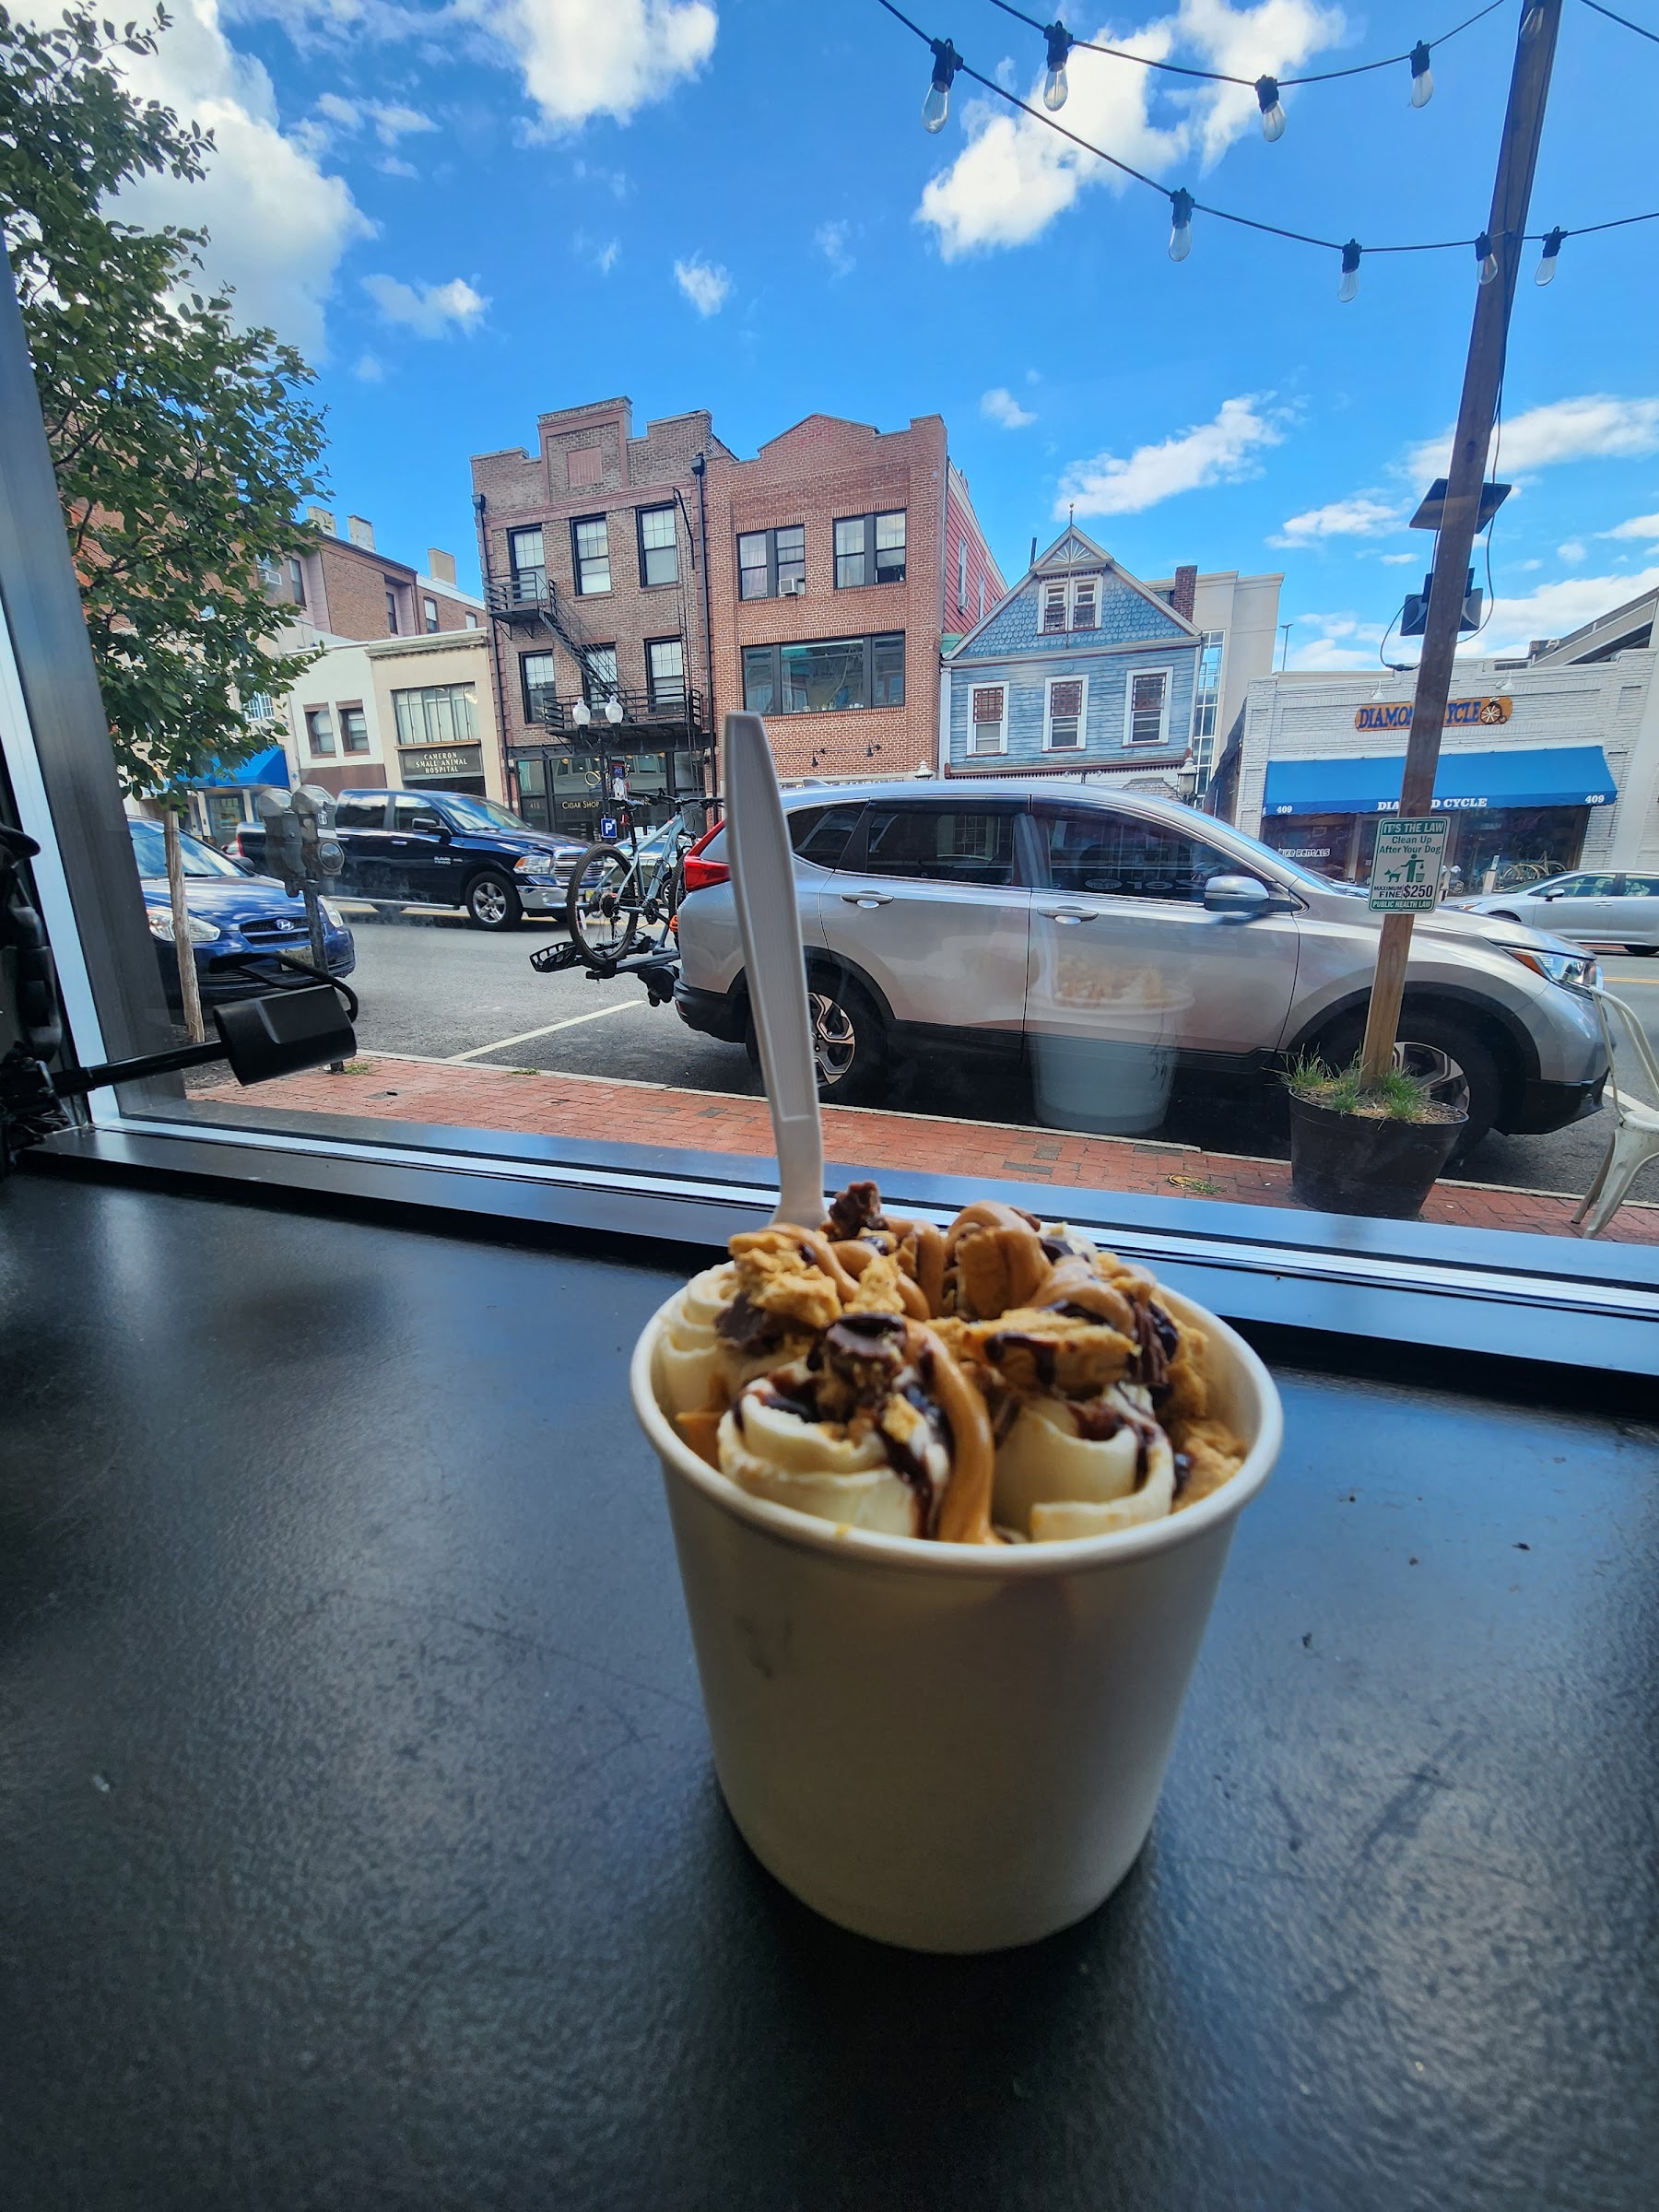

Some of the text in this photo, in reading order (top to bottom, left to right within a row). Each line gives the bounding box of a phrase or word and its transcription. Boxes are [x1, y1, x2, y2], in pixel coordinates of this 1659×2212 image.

[1359, 701, 1481, 728] DIAMO YCLE
[424, 751, 457, 760] CAMERON
[441, 758, 468, 766] ANIMAL
[425, 765, 459, 774] HOSPITAL
[1377, 797, 1488, 811] DIAD CYCLE
[1584, 794, 1605, 804] 409
[561, 800, 600, 809] CIGAR SHOP
[1277, 805, 1293, 814] 409
[605, 822, 613, 834] P
[1383, 822, 1444, 834] IT'S THE LAW
[1392, 835, 1432, 845] Clean Up
[1379, 845, 1441, 854] After Your Dog
[1403, 884, 1433, 899] $250
